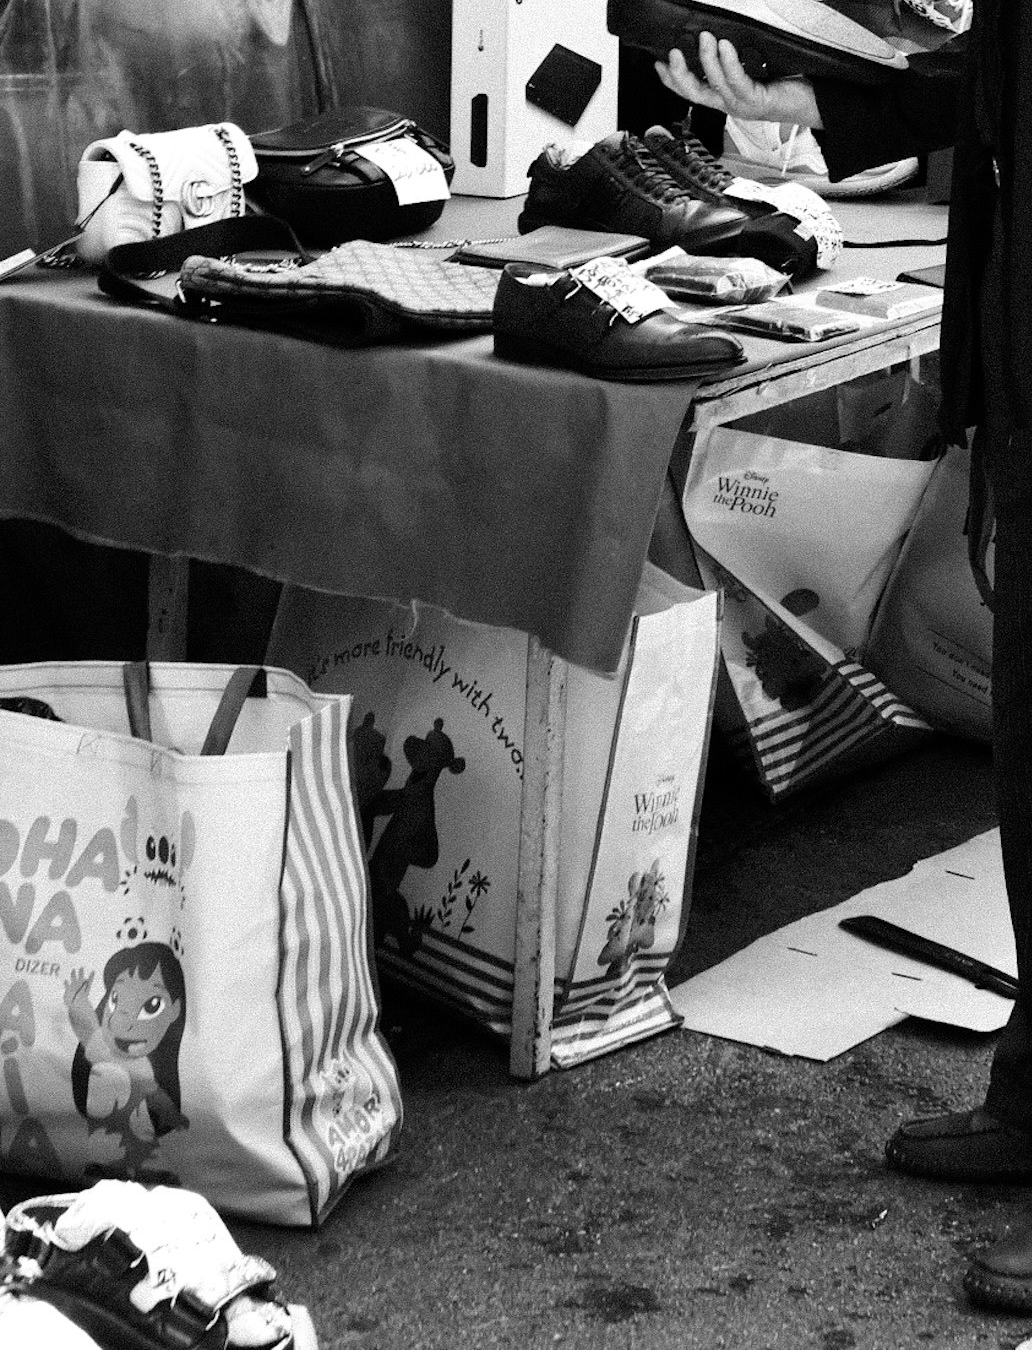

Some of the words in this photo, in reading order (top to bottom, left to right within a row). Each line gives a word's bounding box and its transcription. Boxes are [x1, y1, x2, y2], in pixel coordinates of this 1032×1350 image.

[718, 477, 779, 502] Winnie
[713, 494, 732, 507] the
[729, 496, 777, 518] Pooh
[334, 638, 380, 667] more
[385, 628, 452, 683] friendly
[451, 672, 494, 718] with
[15, 957, 61, 978] DIZER
